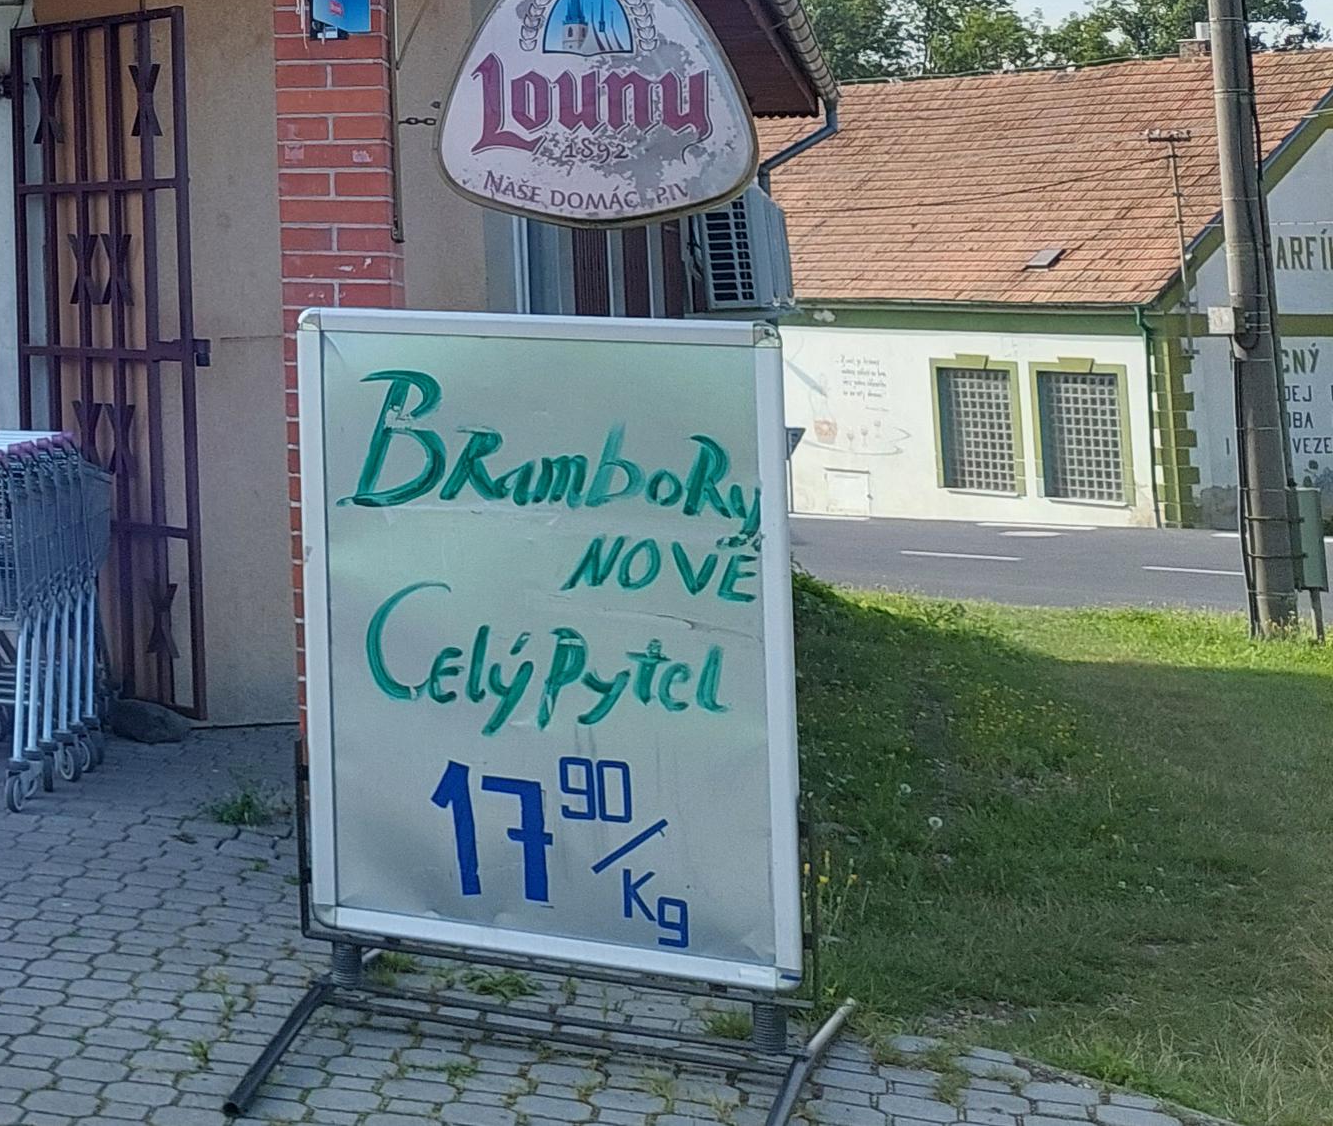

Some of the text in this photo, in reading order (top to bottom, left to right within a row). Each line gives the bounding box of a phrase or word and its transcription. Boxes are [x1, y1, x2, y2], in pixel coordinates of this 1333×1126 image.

[470, 52, 713, 165] Louny
[484, 170, 690, 210] NAŠE DOMÁC PIV
[1277, 228, 1333, 271] ARFÍ
